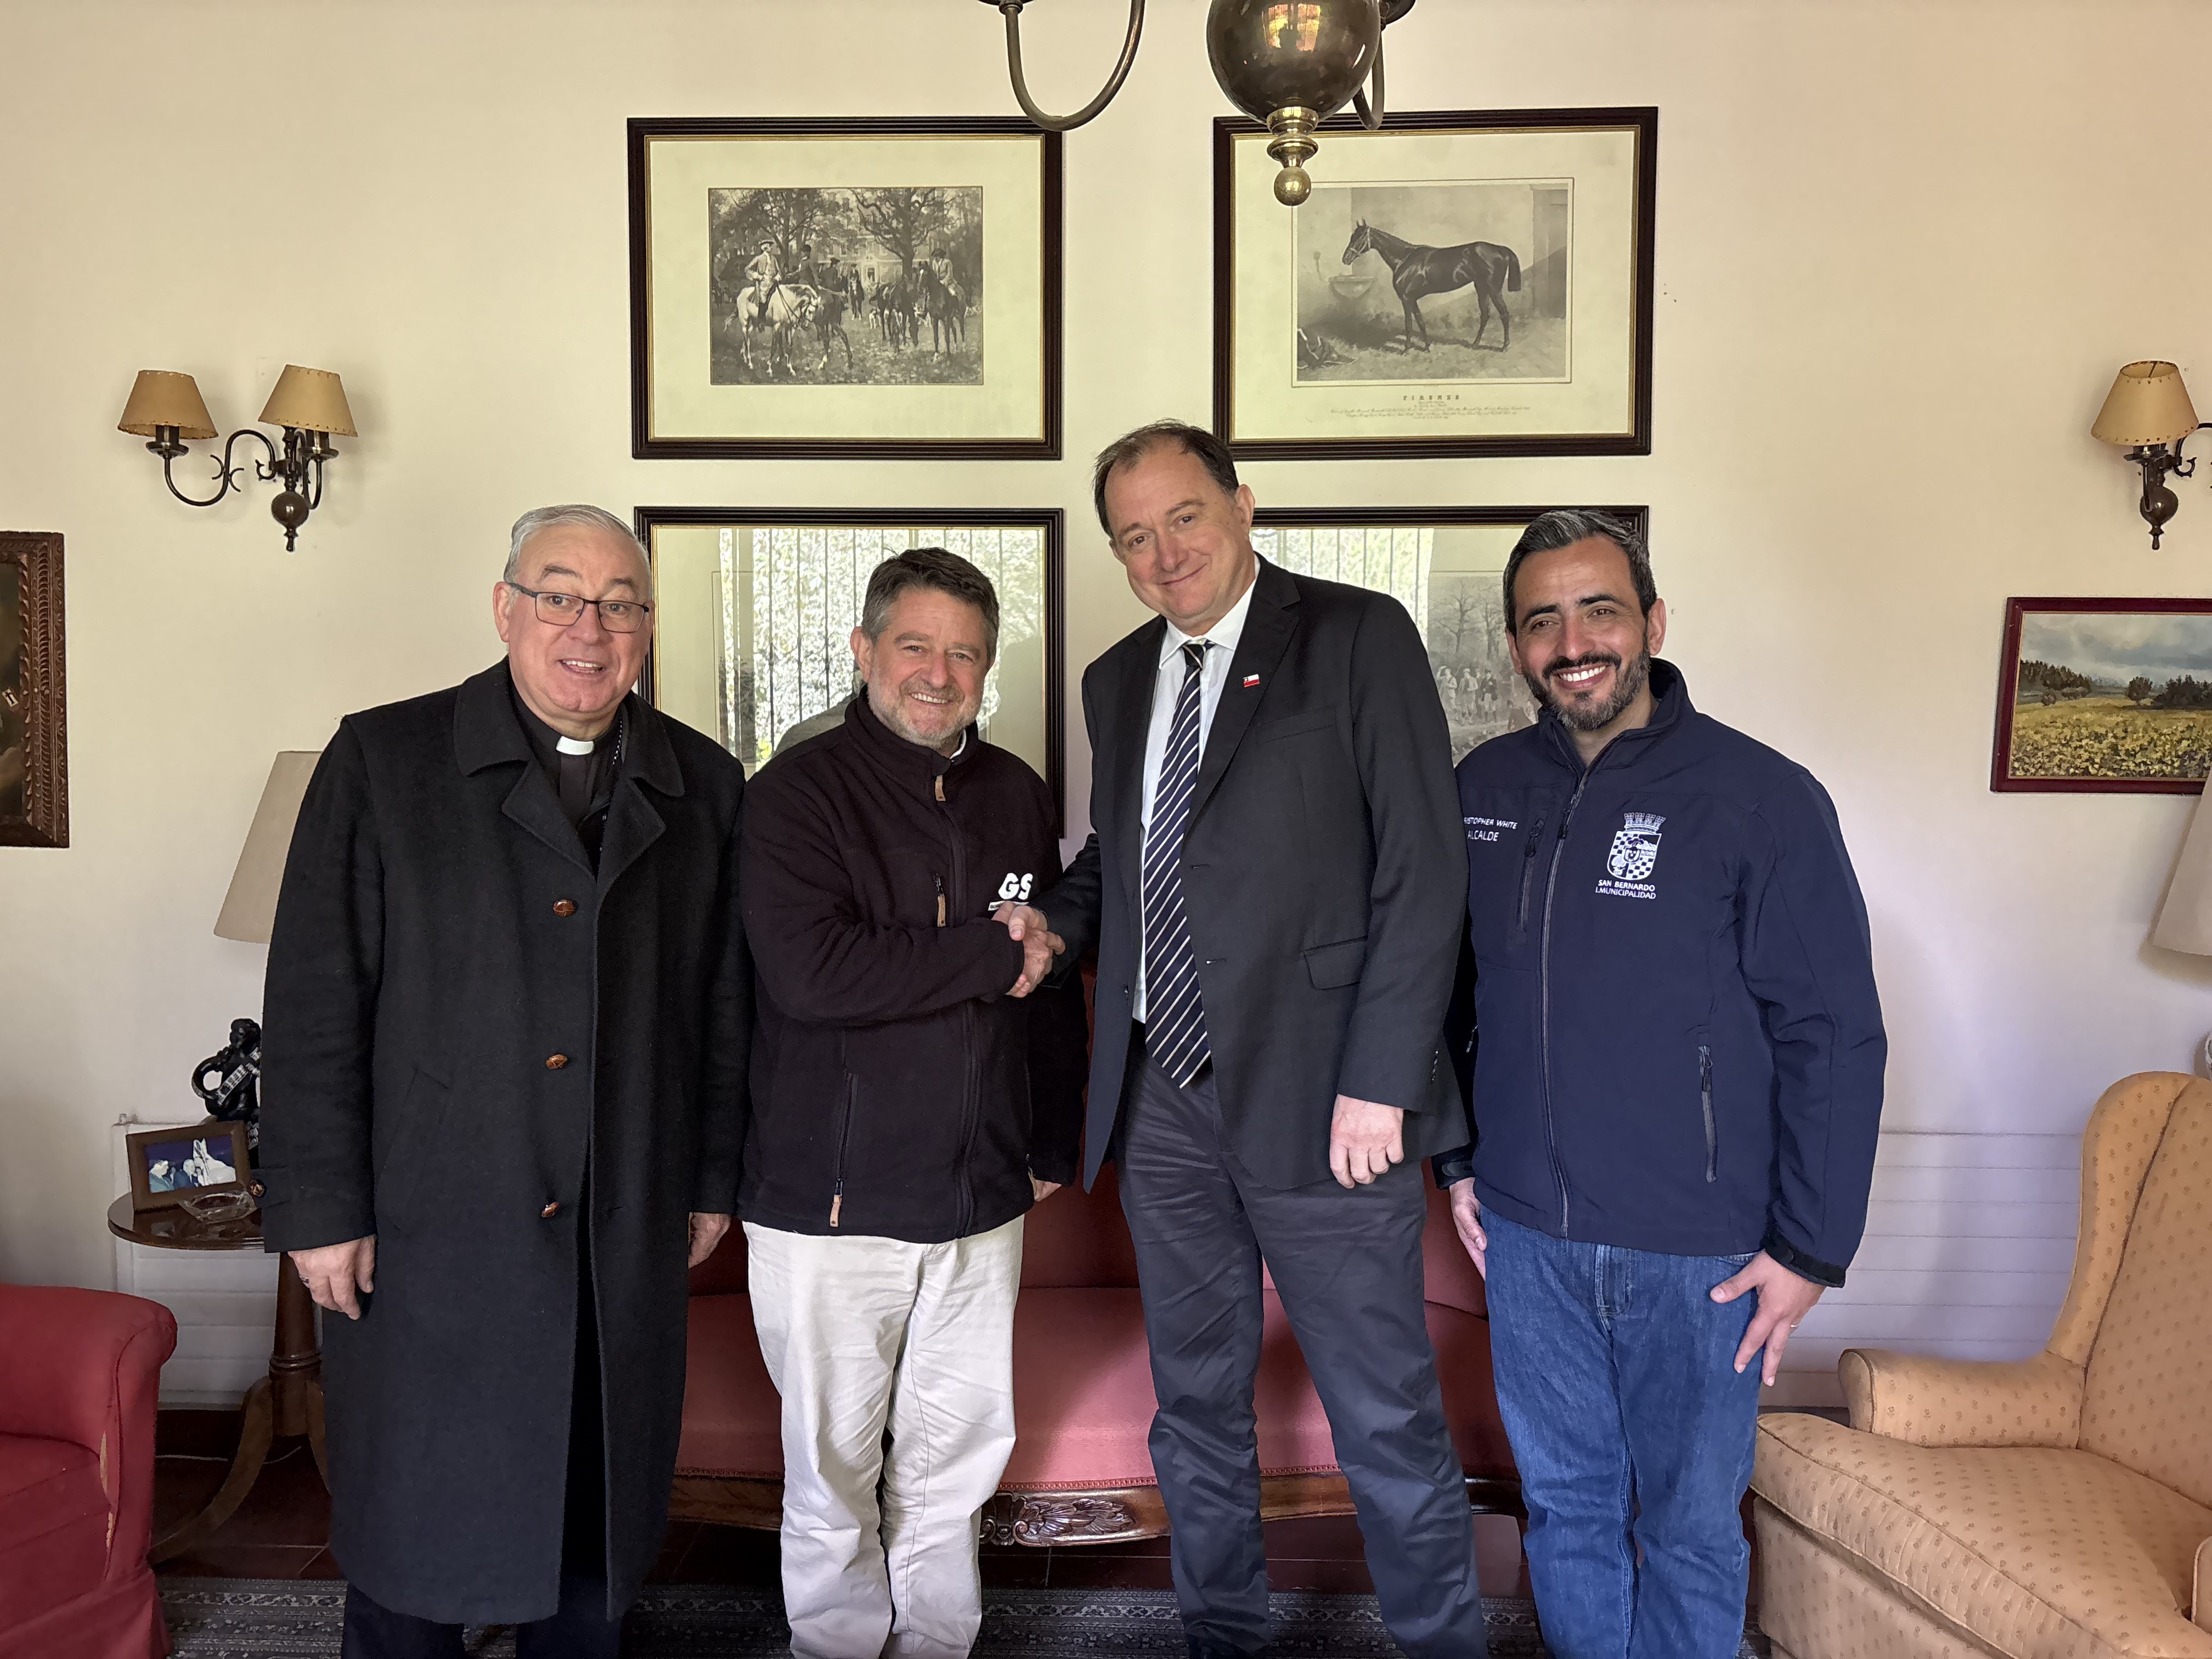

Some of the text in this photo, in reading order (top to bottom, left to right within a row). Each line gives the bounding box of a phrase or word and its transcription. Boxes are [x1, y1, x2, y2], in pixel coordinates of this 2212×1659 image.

[1496, 820, 1518, 829] WHITE
[1467, 830, 1499, 841] ALCALDE
[998, 873, 1033, 900] GS
[1614, 881, 1655, 891] BERNARDO
